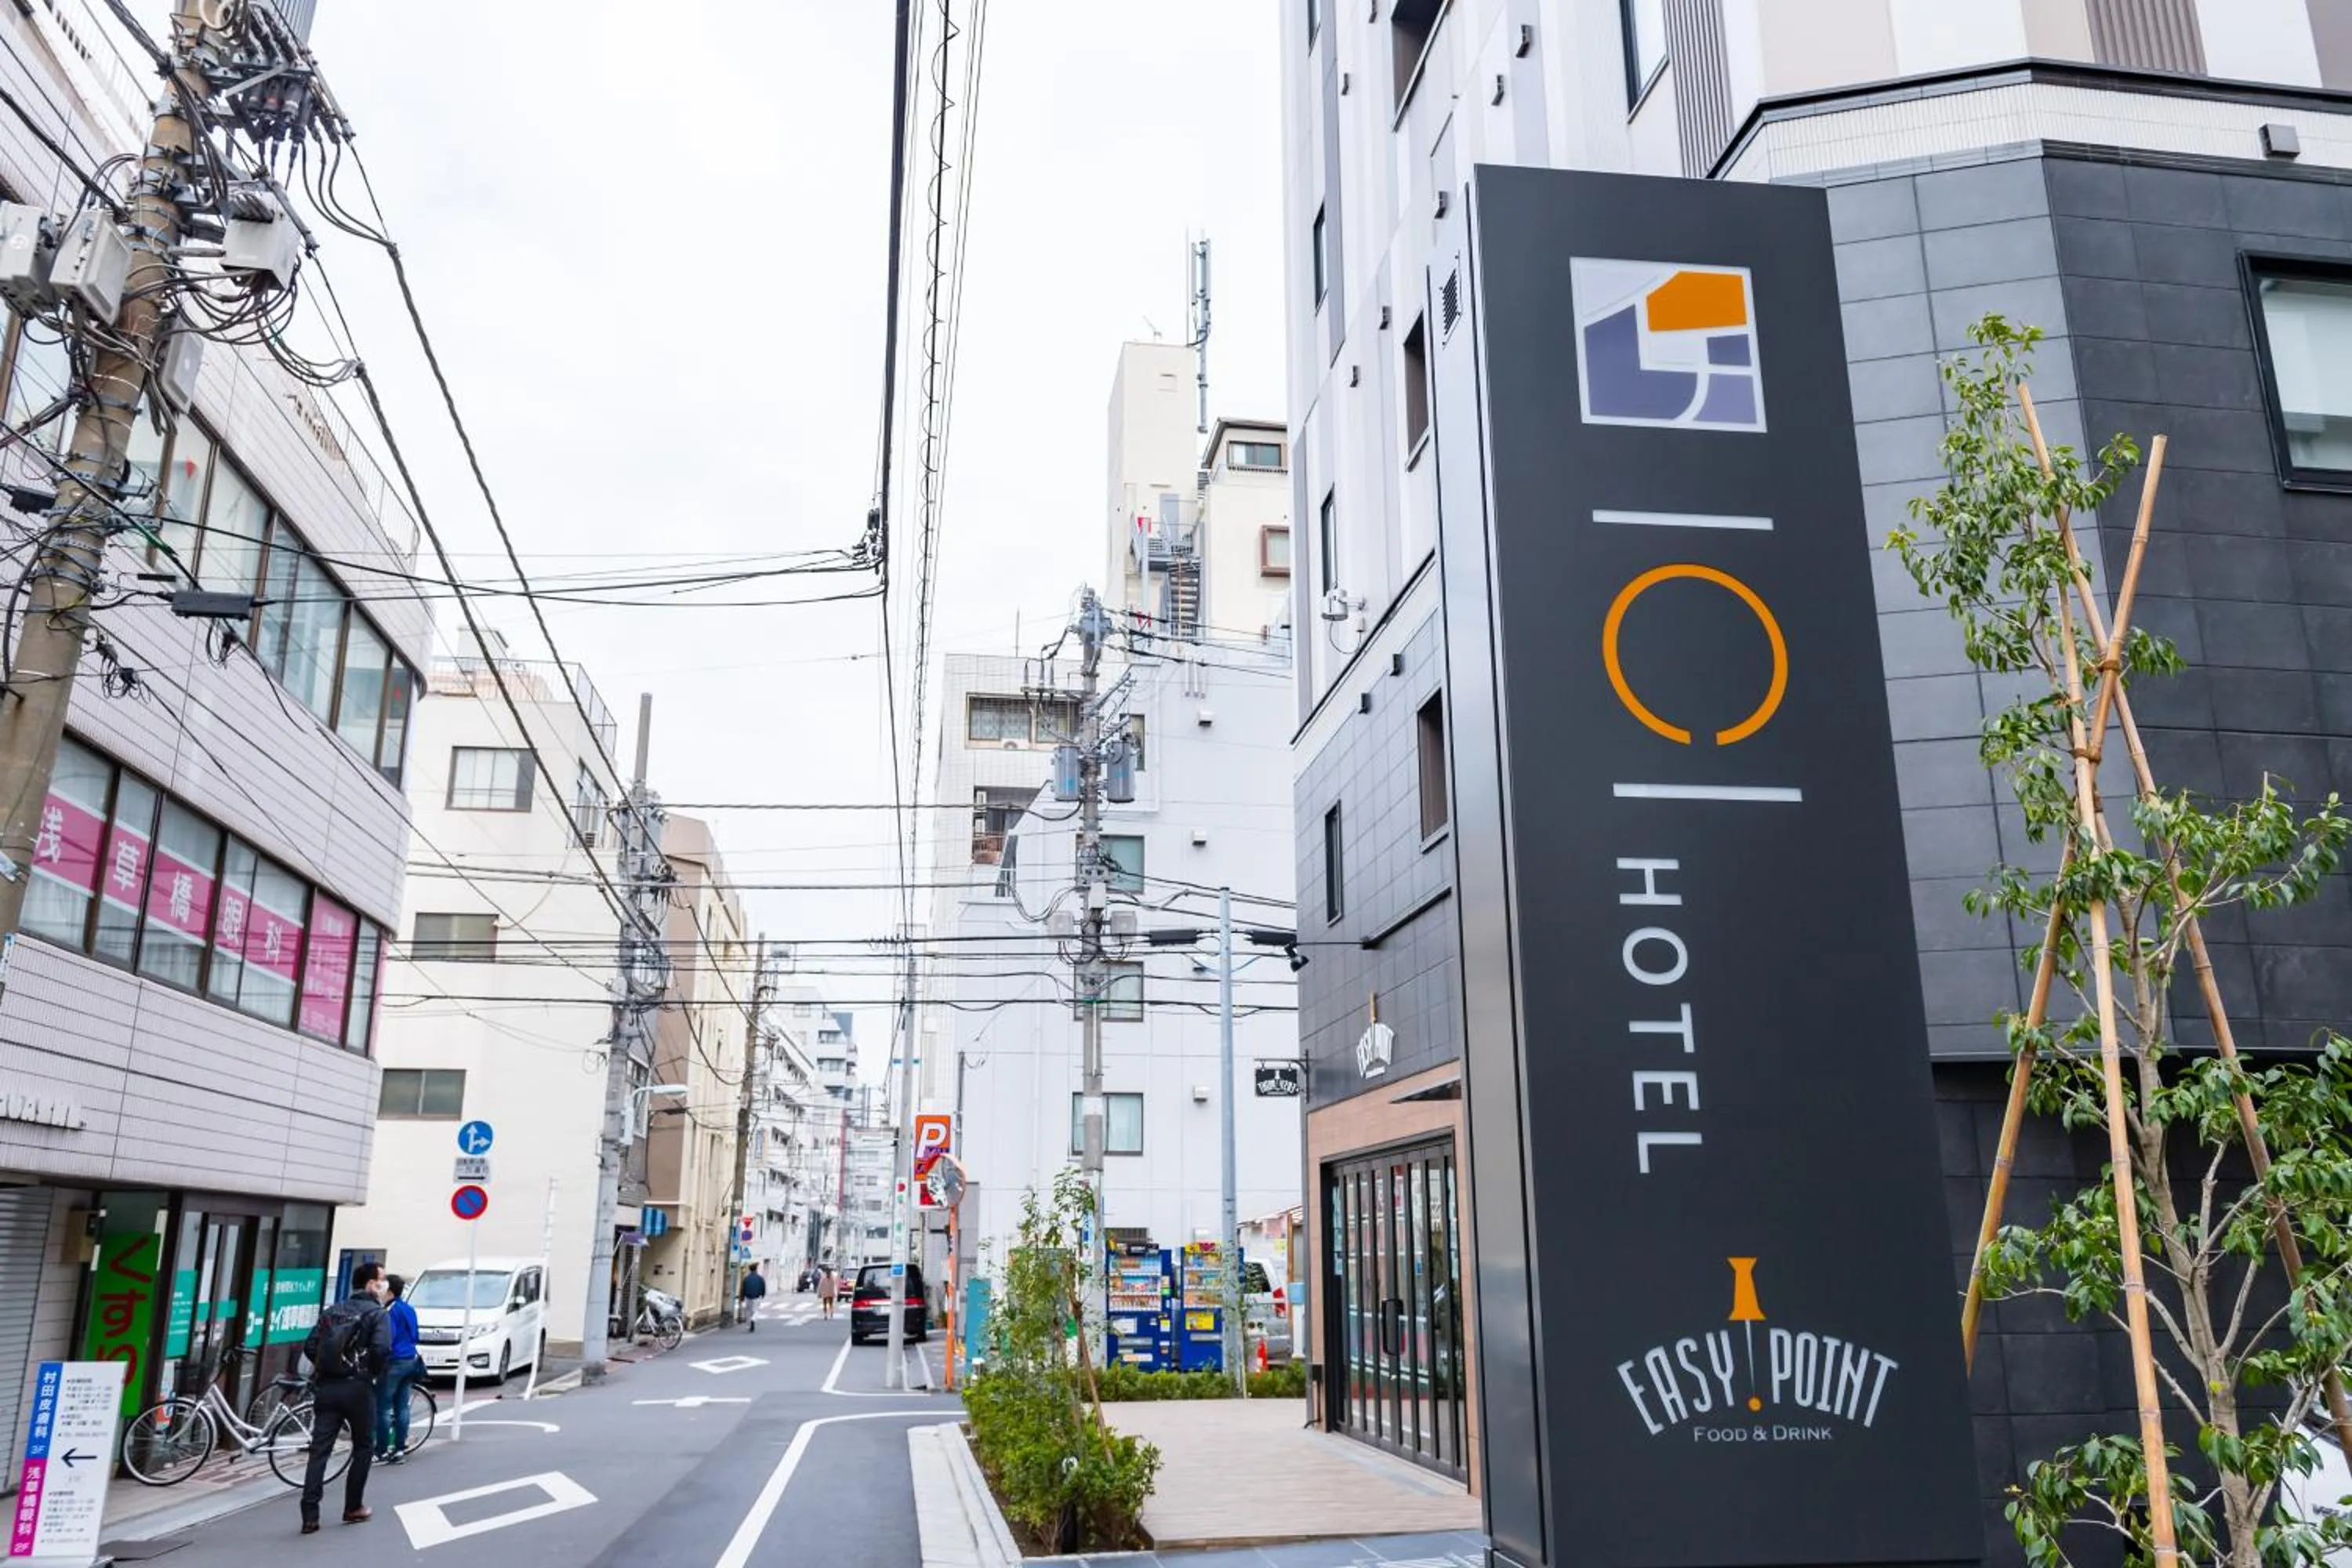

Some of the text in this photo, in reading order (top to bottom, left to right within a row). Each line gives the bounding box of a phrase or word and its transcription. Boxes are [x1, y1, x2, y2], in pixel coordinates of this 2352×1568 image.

[1616, 857, 1703, 1174] HOTEL
[916, 1122, 947, 1158] P
[1617, 1327, 1899, 1436] EASY POINT
[1751, 1425, 1768, 1442] &
